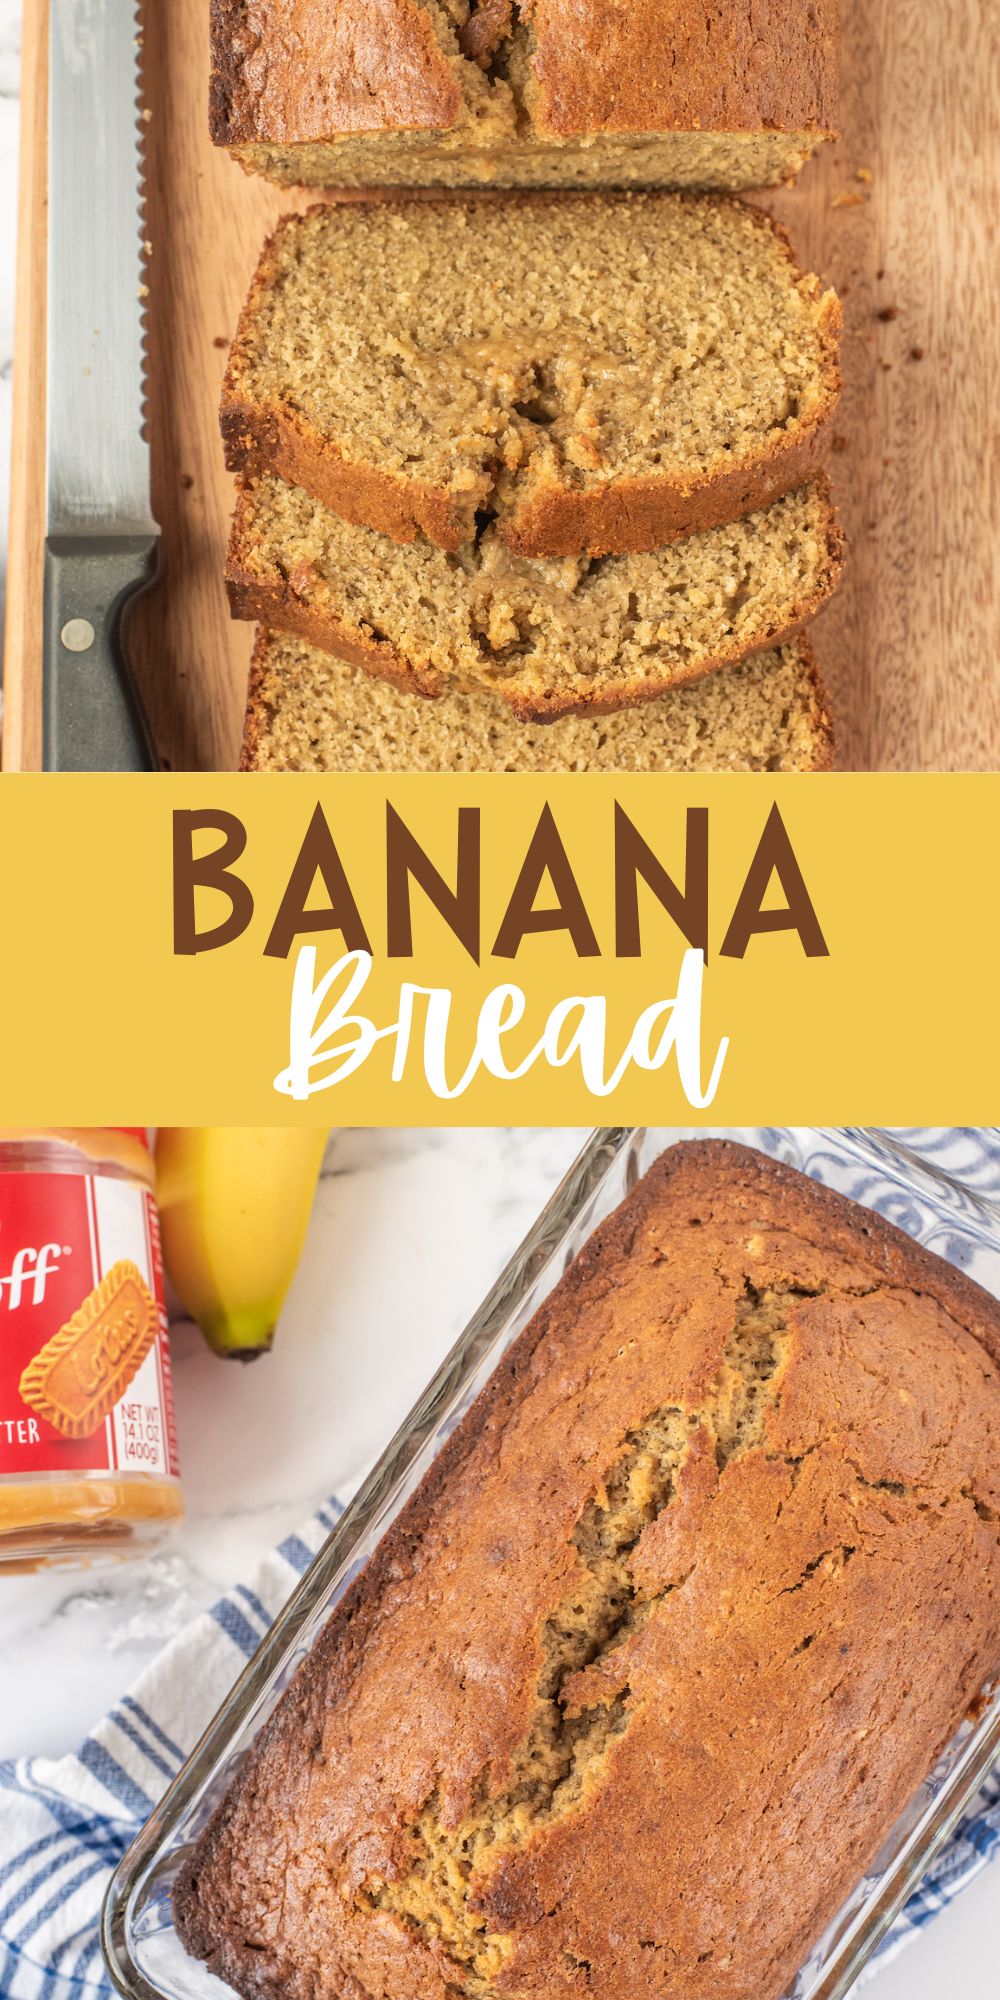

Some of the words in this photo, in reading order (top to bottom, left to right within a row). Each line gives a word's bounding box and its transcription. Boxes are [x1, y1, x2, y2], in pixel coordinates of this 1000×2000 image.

[0, 1243, 61, 1311] ff
[121, 1403, 141, 1420] NET
[145, 1405, 159, 1423] WT
[0, 1417, 40, 1444] TER
[123, 1422, 143, 1440] 14.1
[146, 1424, 159, 1442] OZ
[125, 1442, 159, 1465] (400g)
